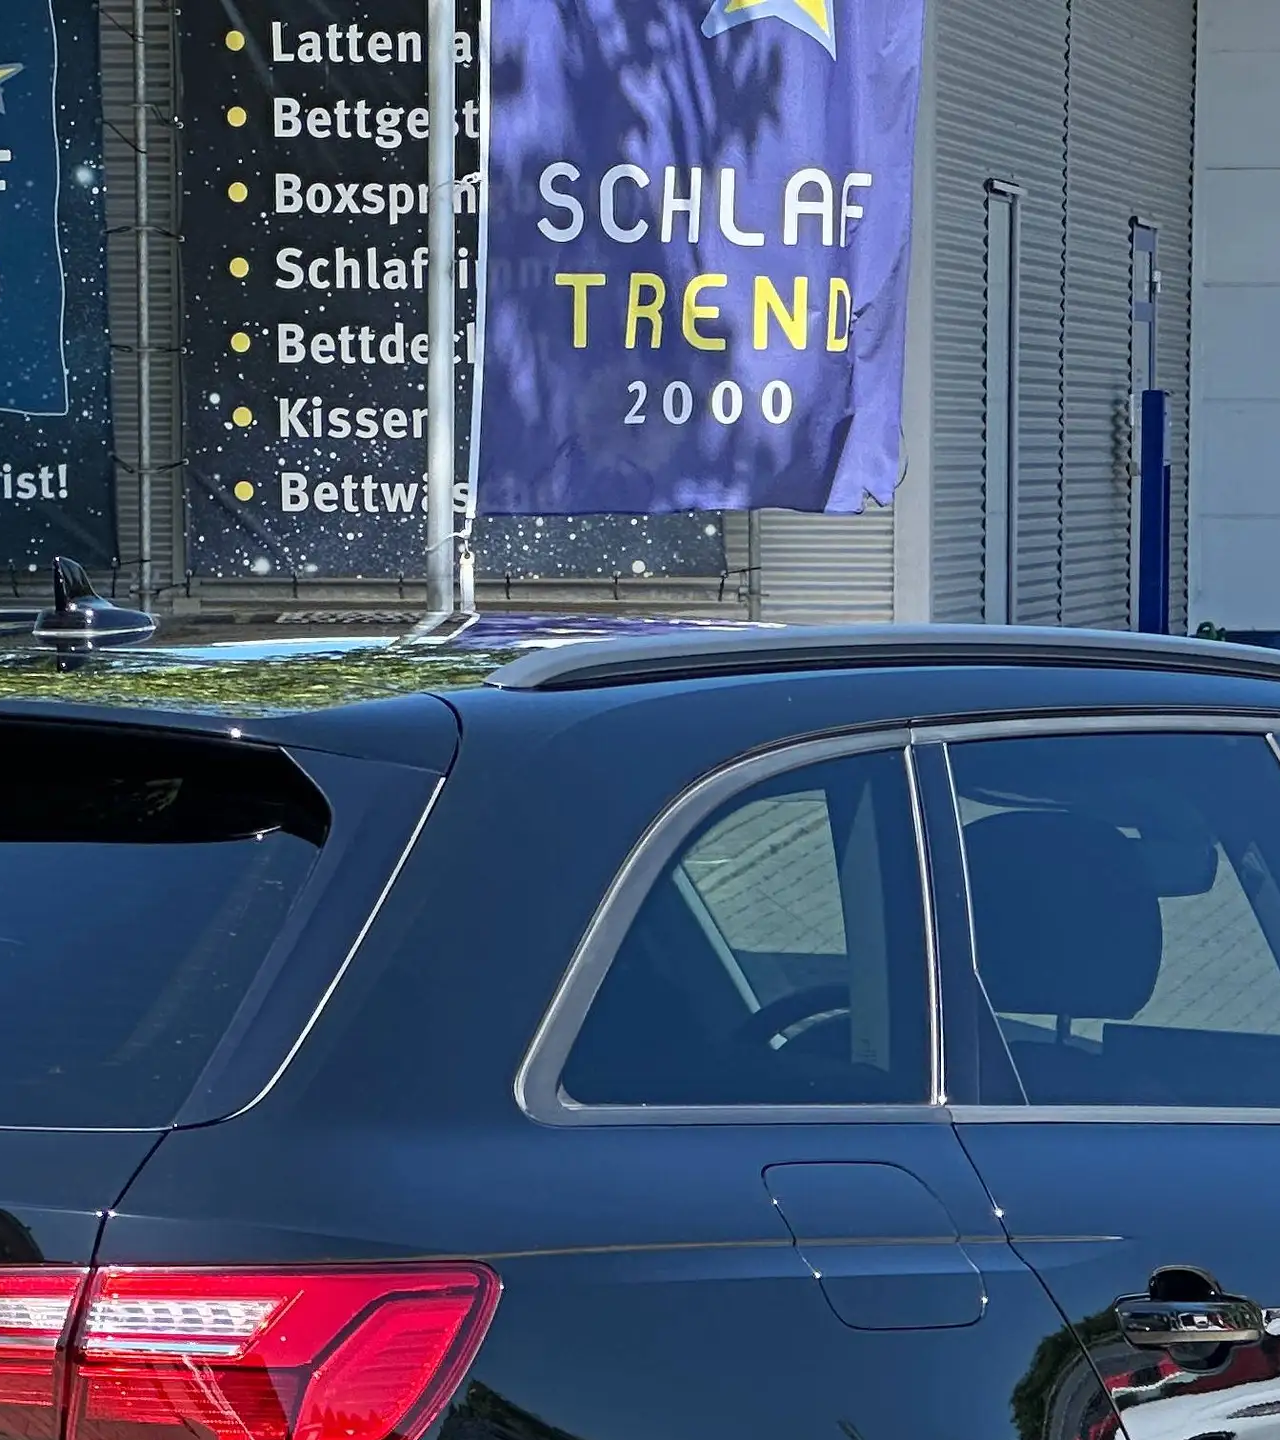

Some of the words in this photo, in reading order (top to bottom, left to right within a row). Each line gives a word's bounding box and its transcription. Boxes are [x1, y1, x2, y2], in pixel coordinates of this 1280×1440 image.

[274, 97, 479, 149] Bettget
[536, 161, 873, 248] SCHLAF
[555, 272, 853, 353] TREND
[623, 380, 795, 426] 2000
